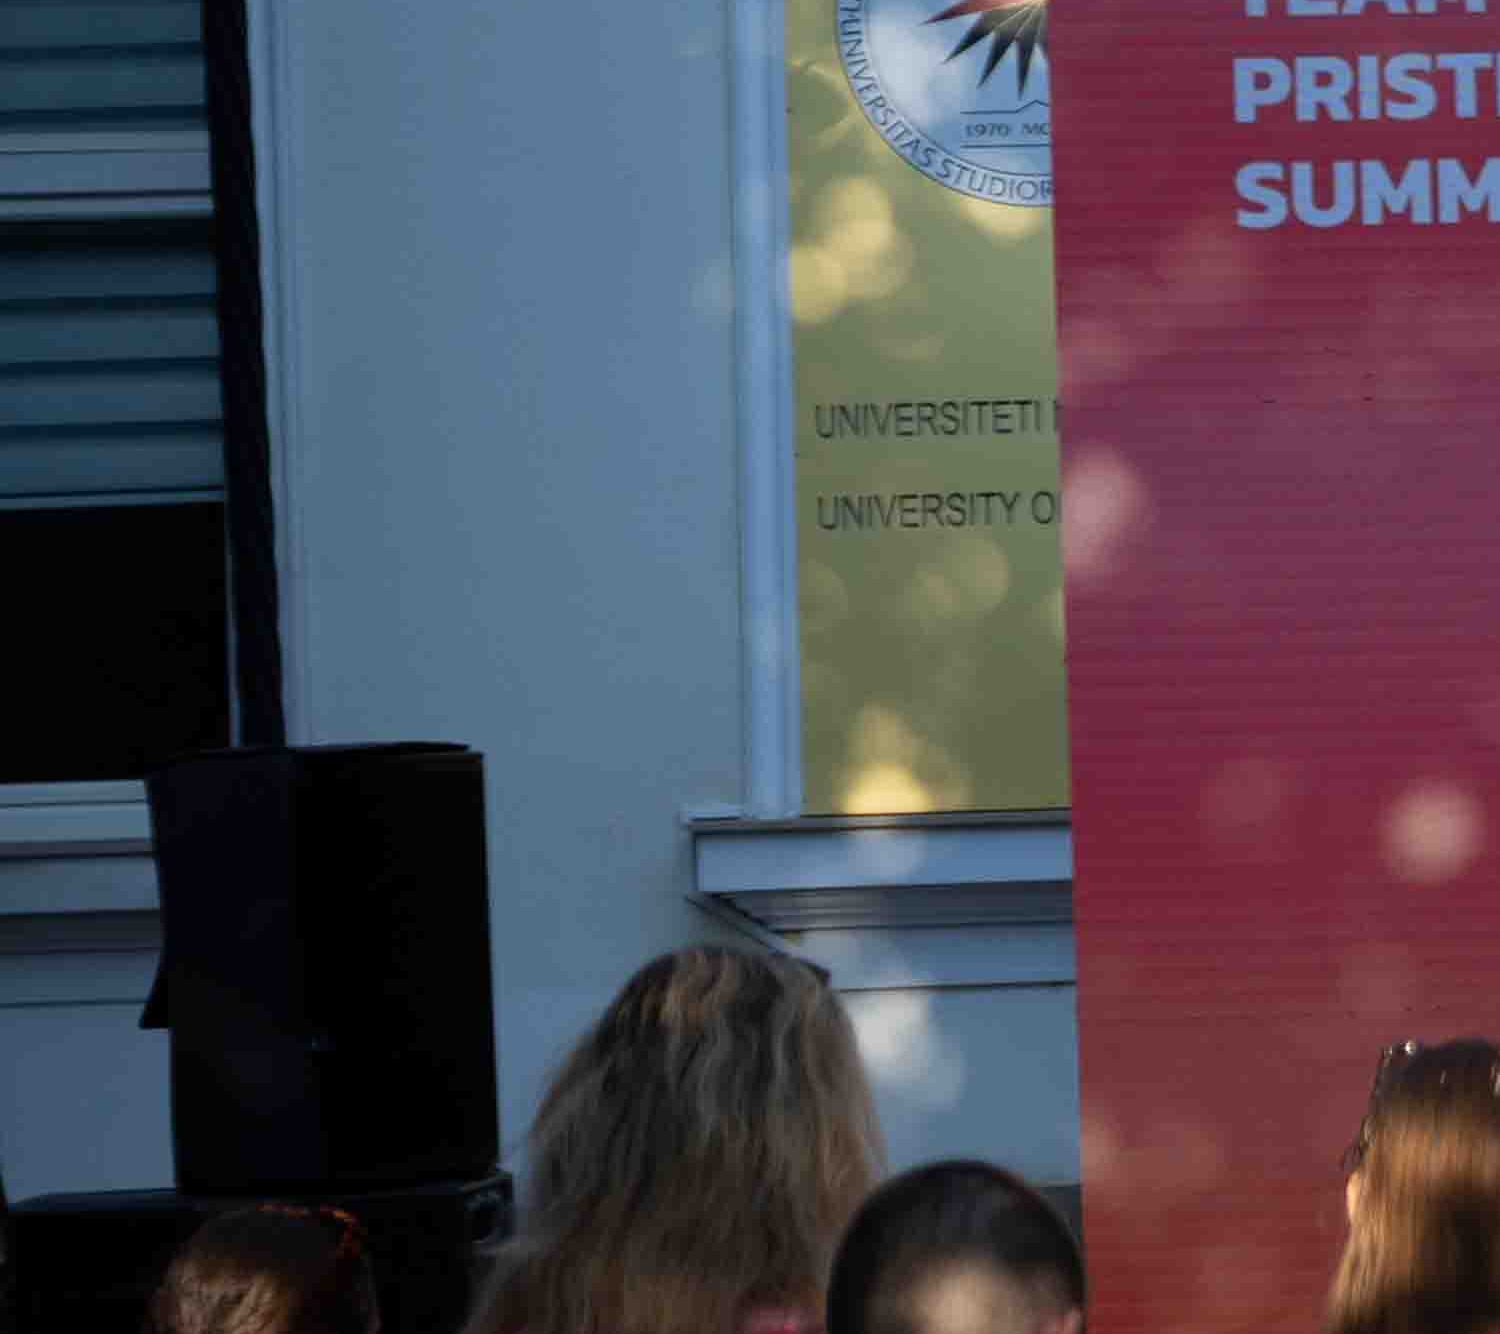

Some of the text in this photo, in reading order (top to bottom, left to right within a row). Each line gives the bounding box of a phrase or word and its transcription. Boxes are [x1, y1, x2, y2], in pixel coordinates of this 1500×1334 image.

[839, 18, 938, 168] UNIVERSITAS
[964, 122, 1010, 138] 1970
[814, 399, 1043, 440] UNIVERSITETI
[816, 491, 1022, 531] UNIVERSITY
